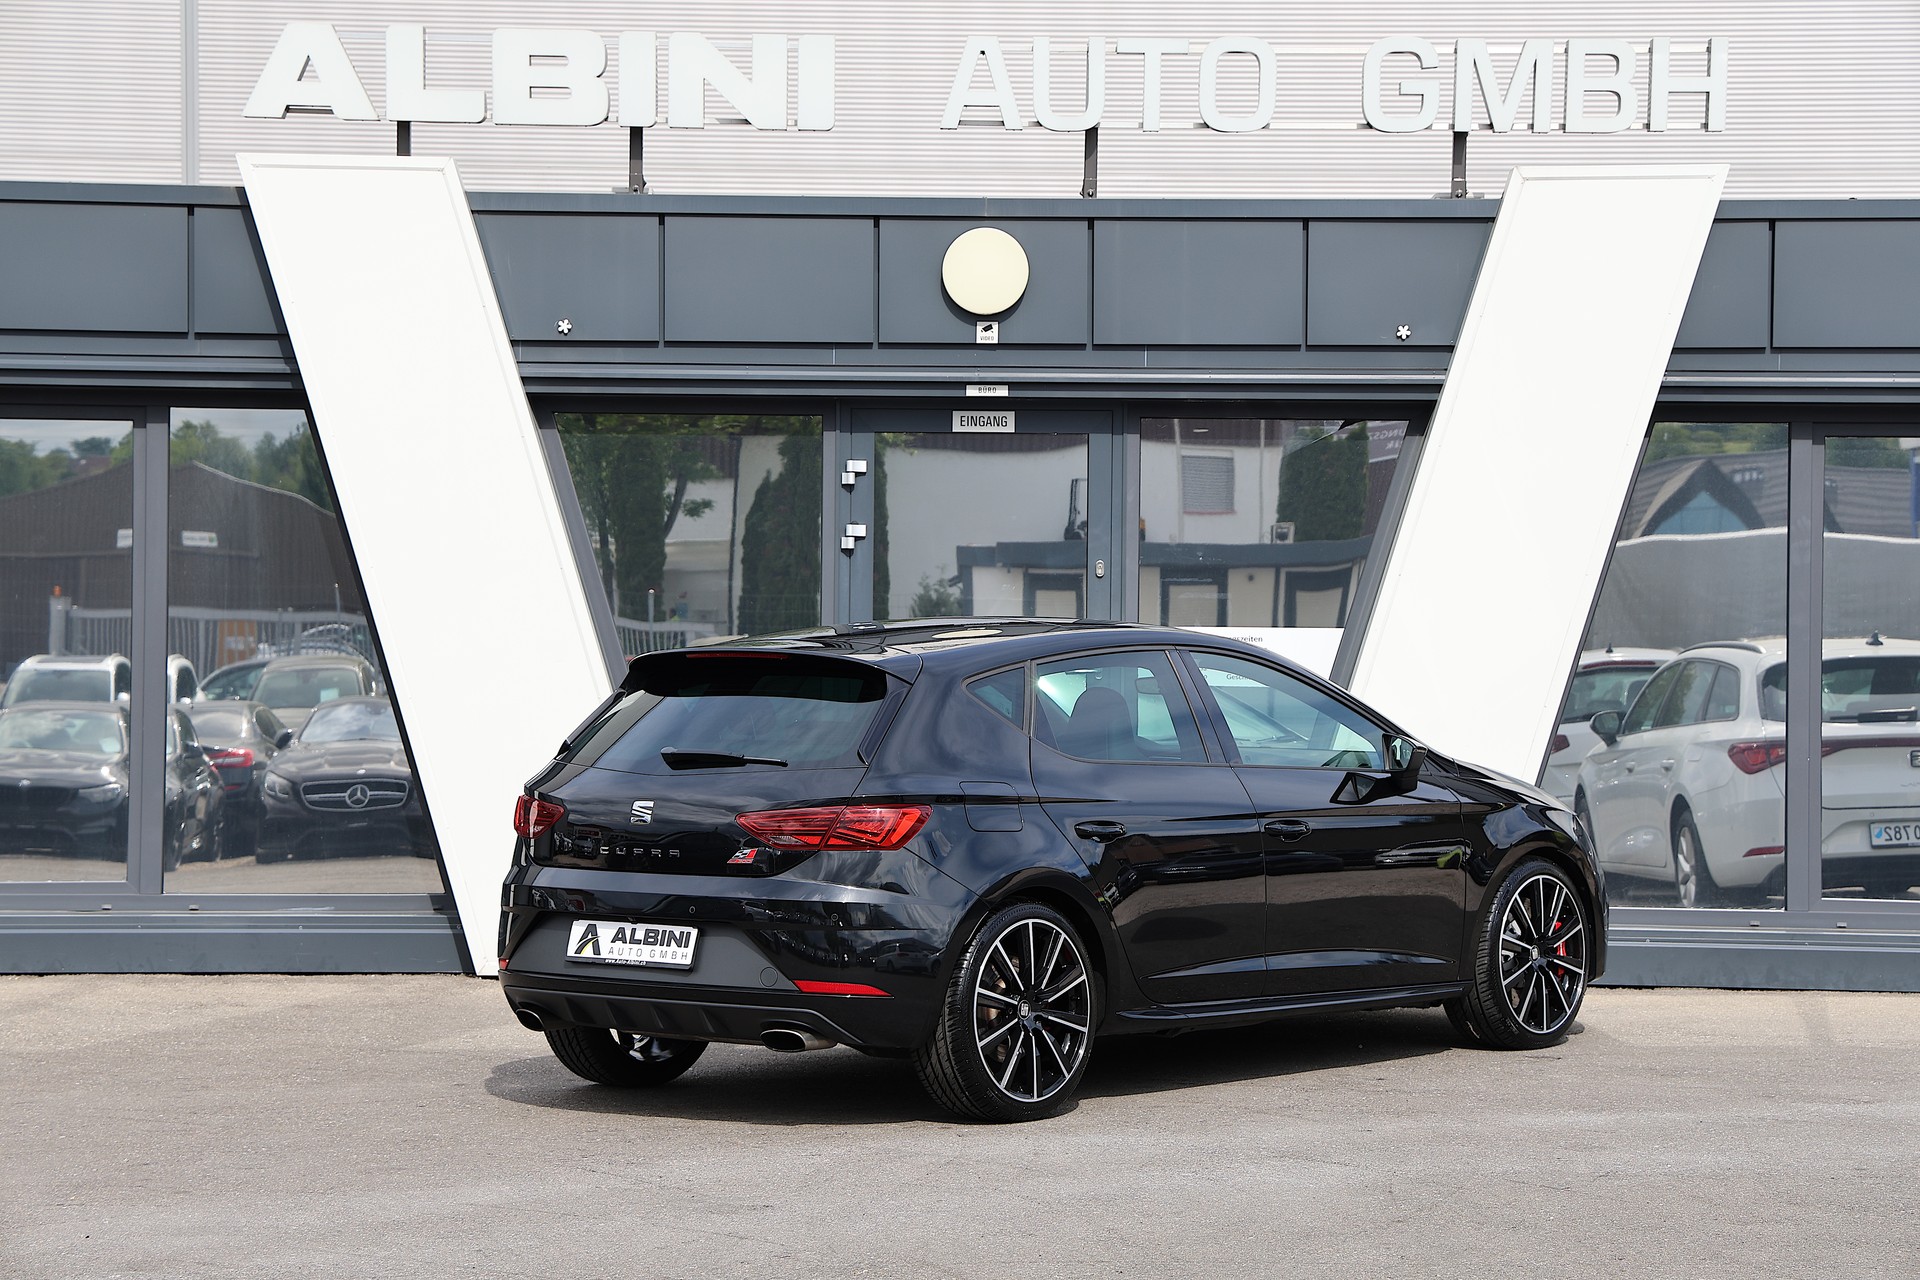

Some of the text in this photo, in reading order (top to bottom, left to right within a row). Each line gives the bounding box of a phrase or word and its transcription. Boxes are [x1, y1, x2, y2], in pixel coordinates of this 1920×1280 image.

[242, 23, 1730, 134] ALBINI AUTO GMBH
[978, 386, 997, 394] BÜRO
[960, 415, 1008, 427] EINGANG
[600, 846, 680, 858] CUPRA
[610, 926, 692, 949] ALBINI
[608, 946, 688, 961] AUTO GMBH
